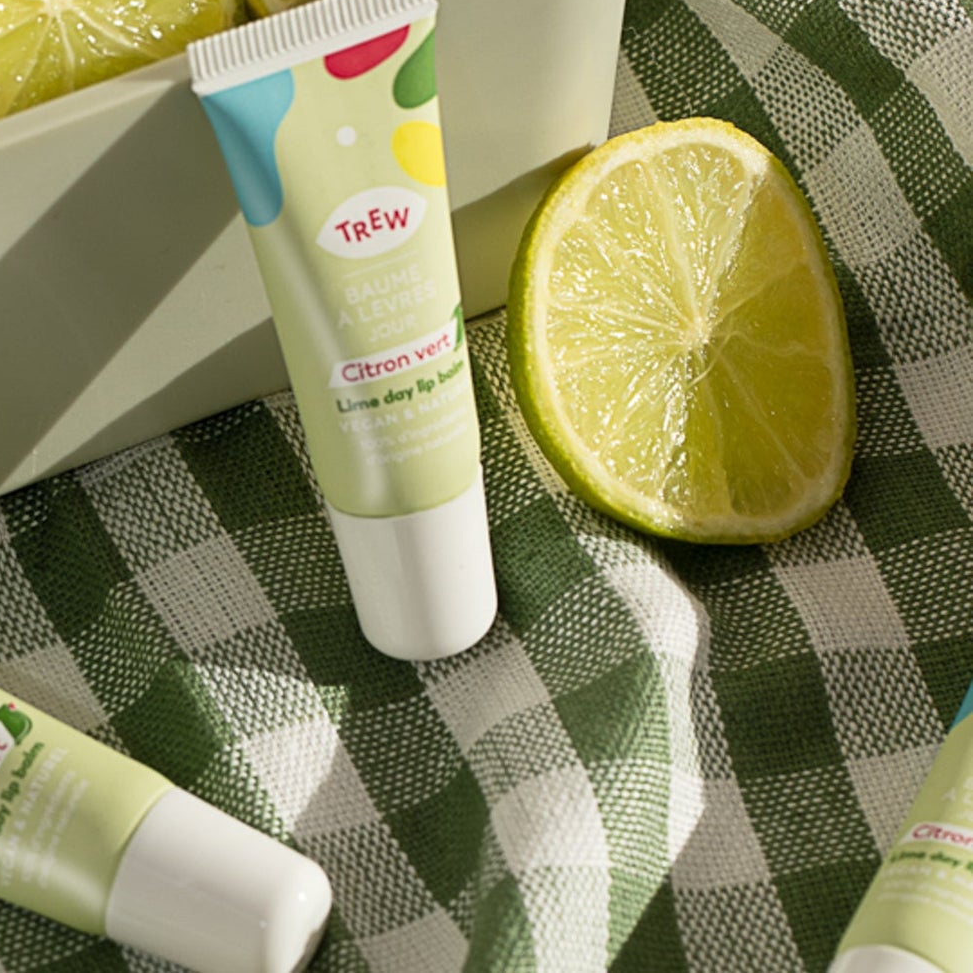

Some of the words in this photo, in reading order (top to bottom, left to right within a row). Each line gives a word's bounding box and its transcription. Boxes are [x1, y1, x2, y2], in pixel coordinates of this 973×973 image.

[335, 207, 410, 243] TREW
[344, 263, 421, 305] BAUME
[368, 313, 419, 342] JOUR
[341, 354, 411, 382] Citron
[414, 334, 451, 360] vert
[336, 397, 380, 414] Lime
[383, 387, 414, 405] day
[416, 378, 435, 393] lip
[0, 781, 21, 803] lip
[11, 742, 45, 779] balm
